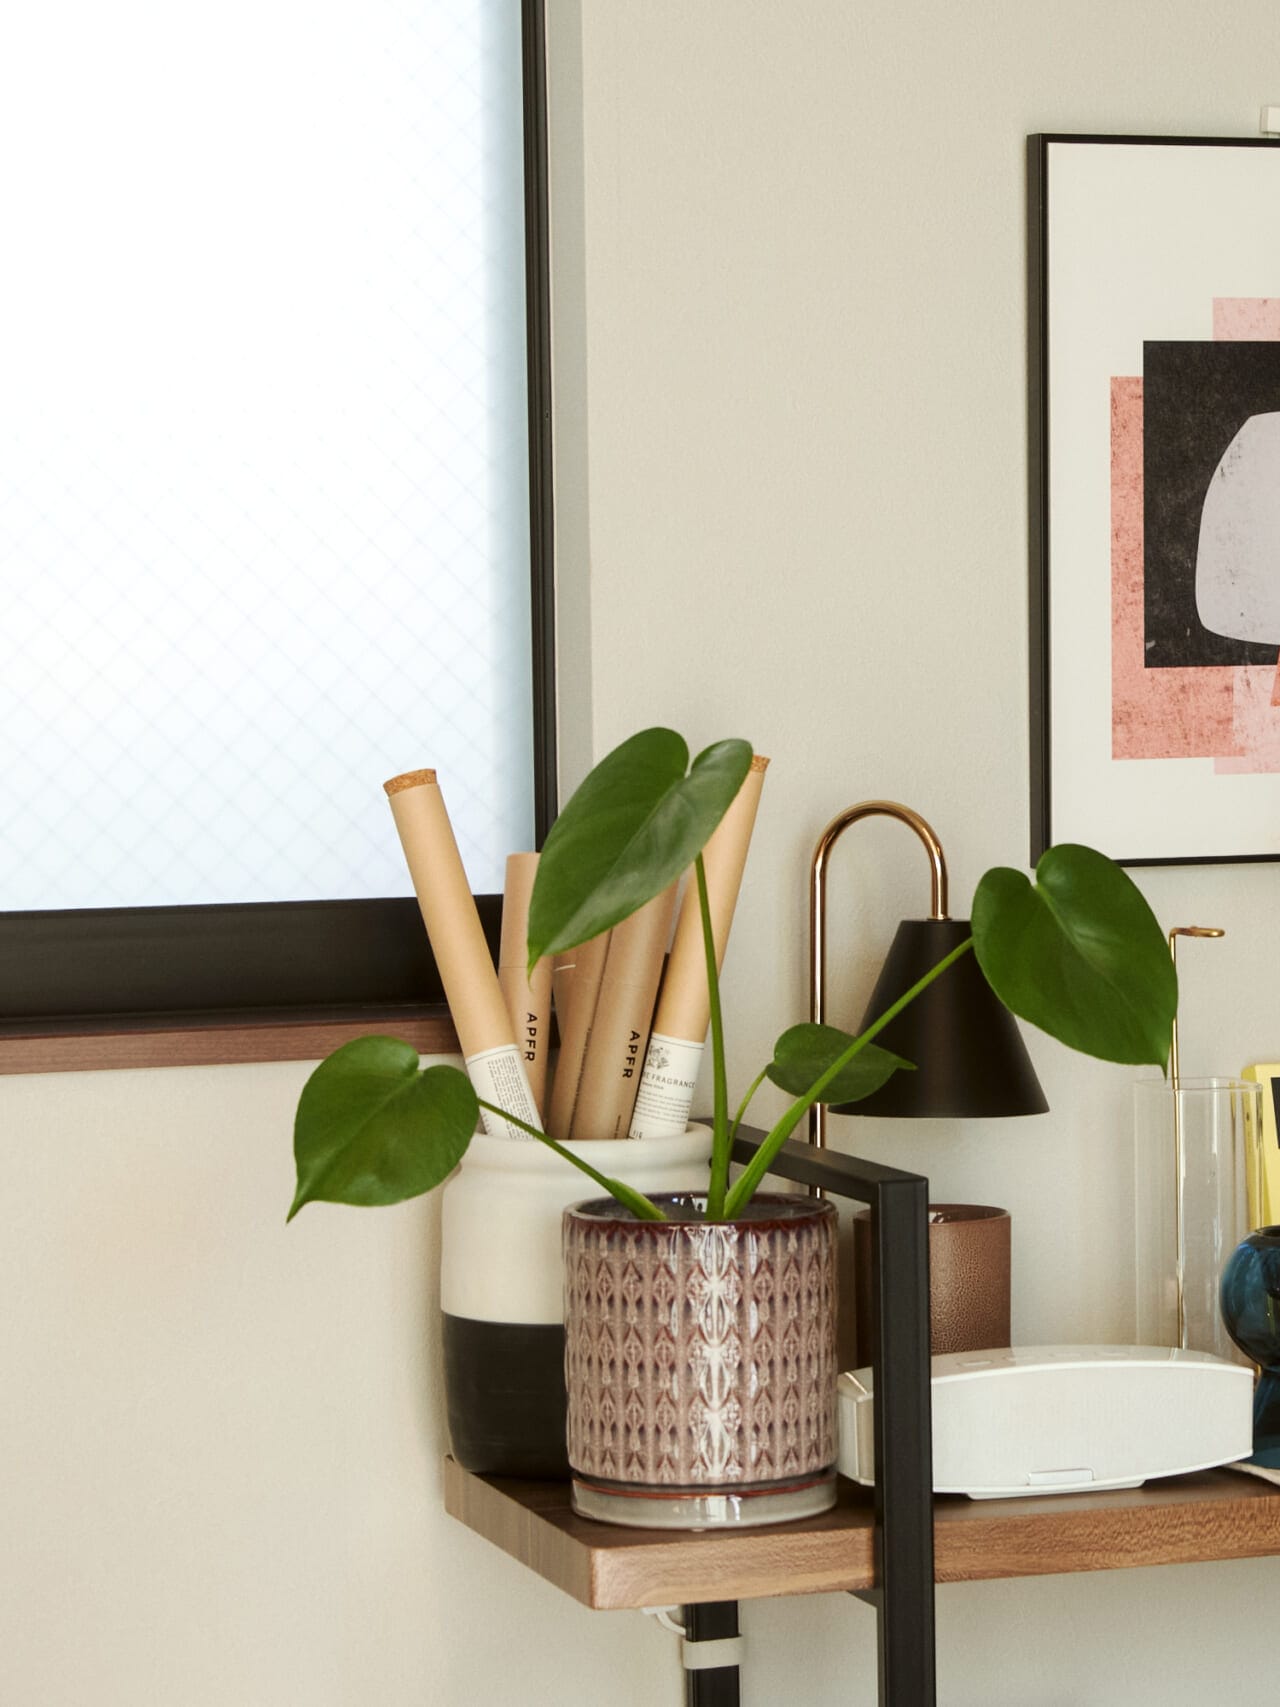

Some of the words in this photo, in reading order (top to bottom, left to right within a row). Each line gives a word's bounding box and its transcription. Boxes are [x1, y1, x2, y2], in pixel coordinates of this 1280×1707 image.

[524, 1012, 538, 1062] APFR
[622, 1030, 640, 1079] APFR
[652, 1074, 696, 1089] FRAGRANCE
